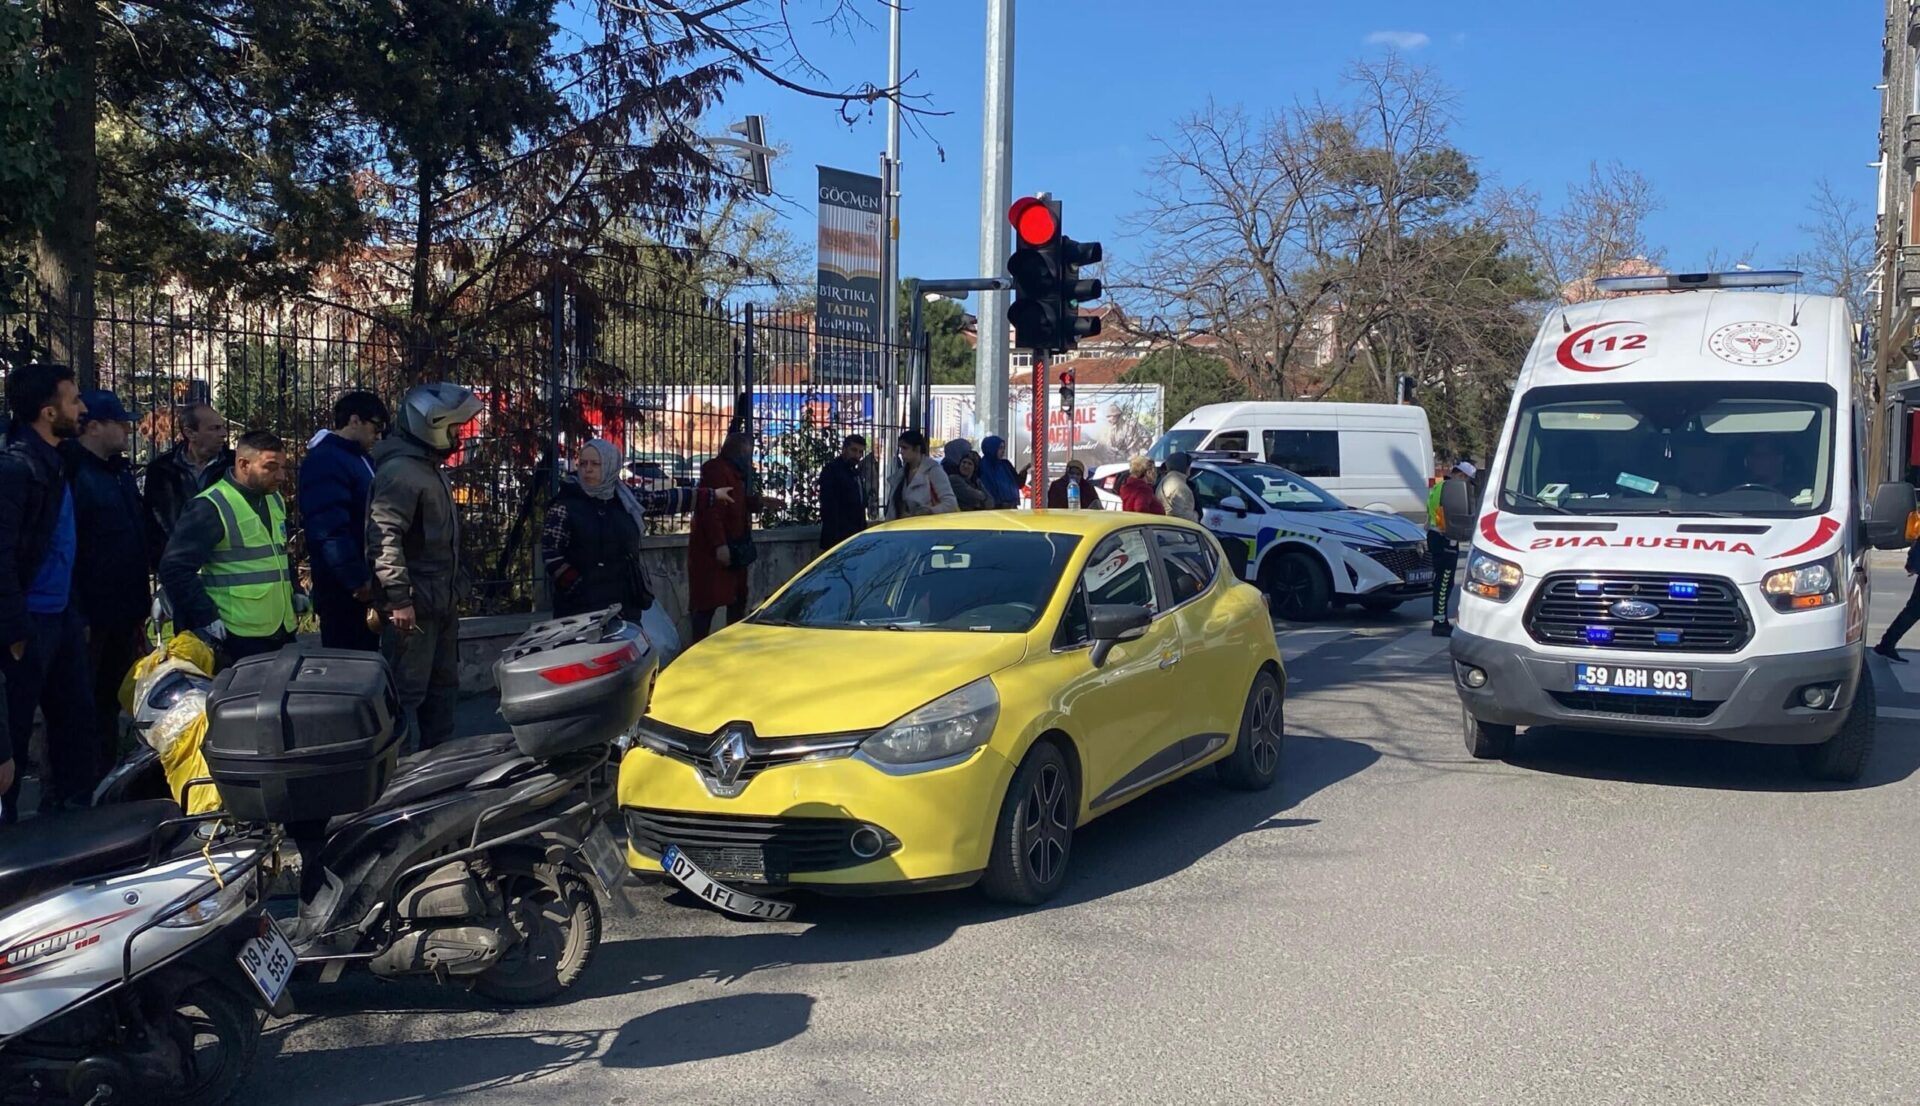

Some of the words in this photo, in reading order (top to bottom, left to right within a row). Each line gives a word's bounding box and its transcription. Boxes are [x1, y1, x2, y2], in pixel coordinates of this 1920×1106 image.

[820, 186, 879, 209] GÖÇMEN
[819, 284, 842, 301] BİR
[842, 288, 875, 304] TIKLA
[826, 302, 869, 318] TATLIN
[819, 316, 871, 333] KAPINDA
[1576, 334, 1648, 354] 112
[1025, 407, 1097, 432] ÇAKALE
[1620, 604, 1649, 616] Ford
[1586, 666, 1608, 685] 59
[1614, 668, 1647, 688] ABH
[1653, 671, 1688, 690] 903
[673, 857, 696, 882] 07
[702, 882, 736, 910] AFL
[749, 901, 791, 919] 217
[243, 947, 262, 974] 09
[267, 947, 288, 982] 555
